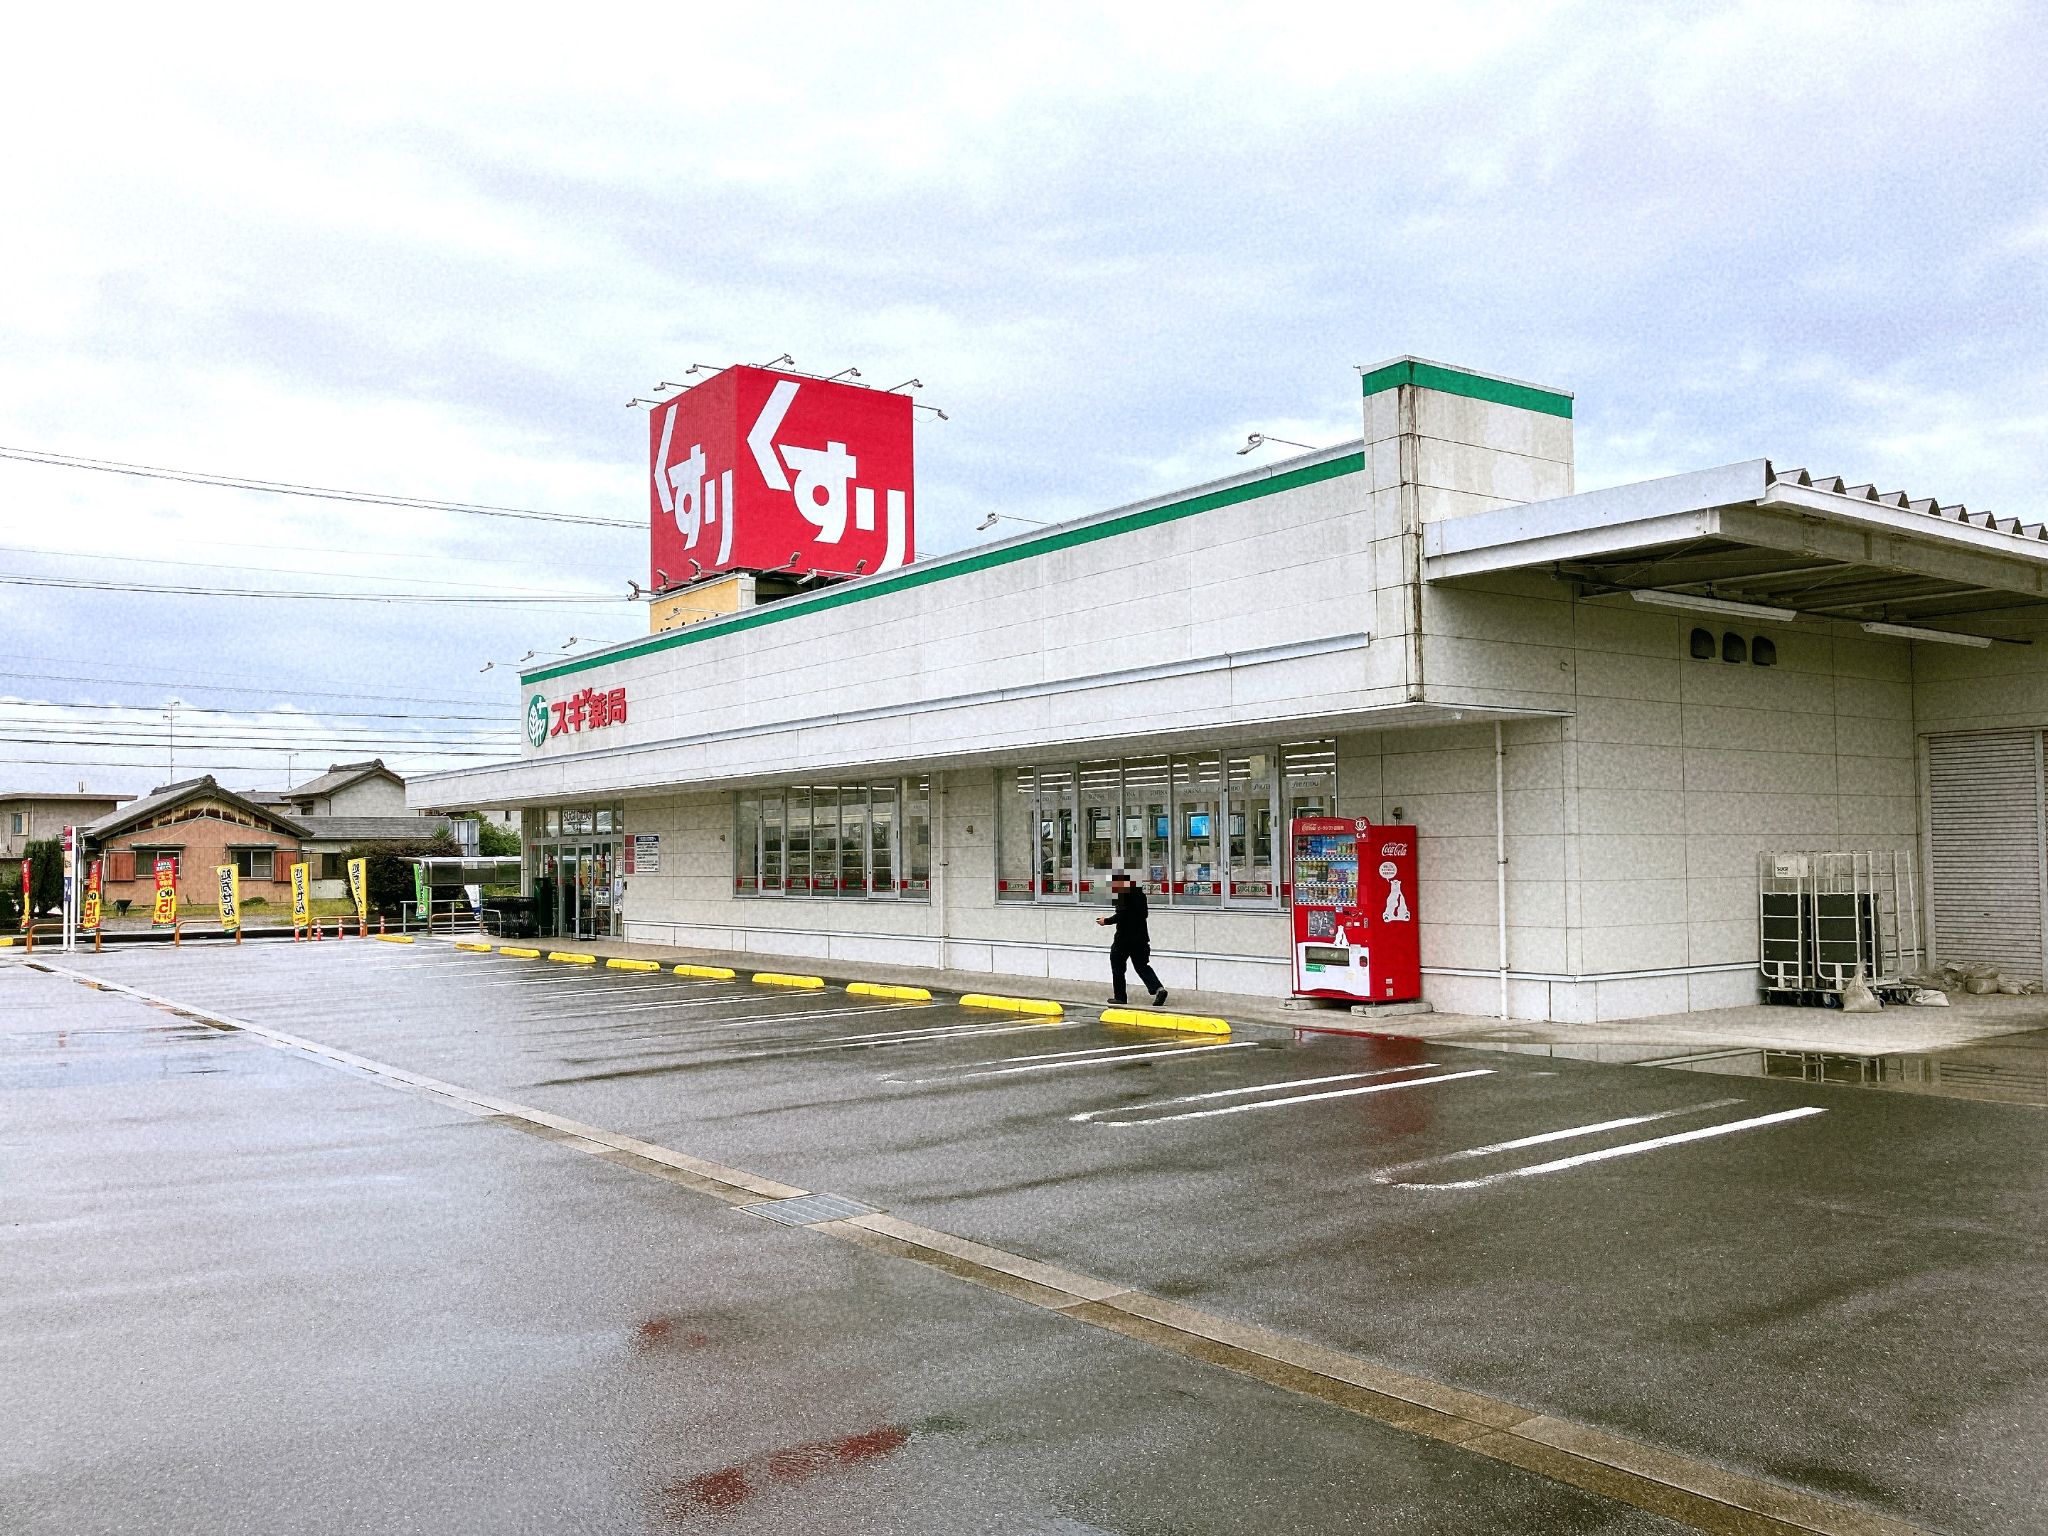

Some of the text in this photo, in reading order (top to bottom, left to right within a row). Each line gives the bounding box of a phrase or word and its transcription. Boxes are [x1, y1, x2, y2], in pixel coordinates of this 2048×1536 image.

[654, 403, 733, 566] くすり
[747, 379, 906, 575] くすり
[550, 687, 626, 736] スギ薬局
